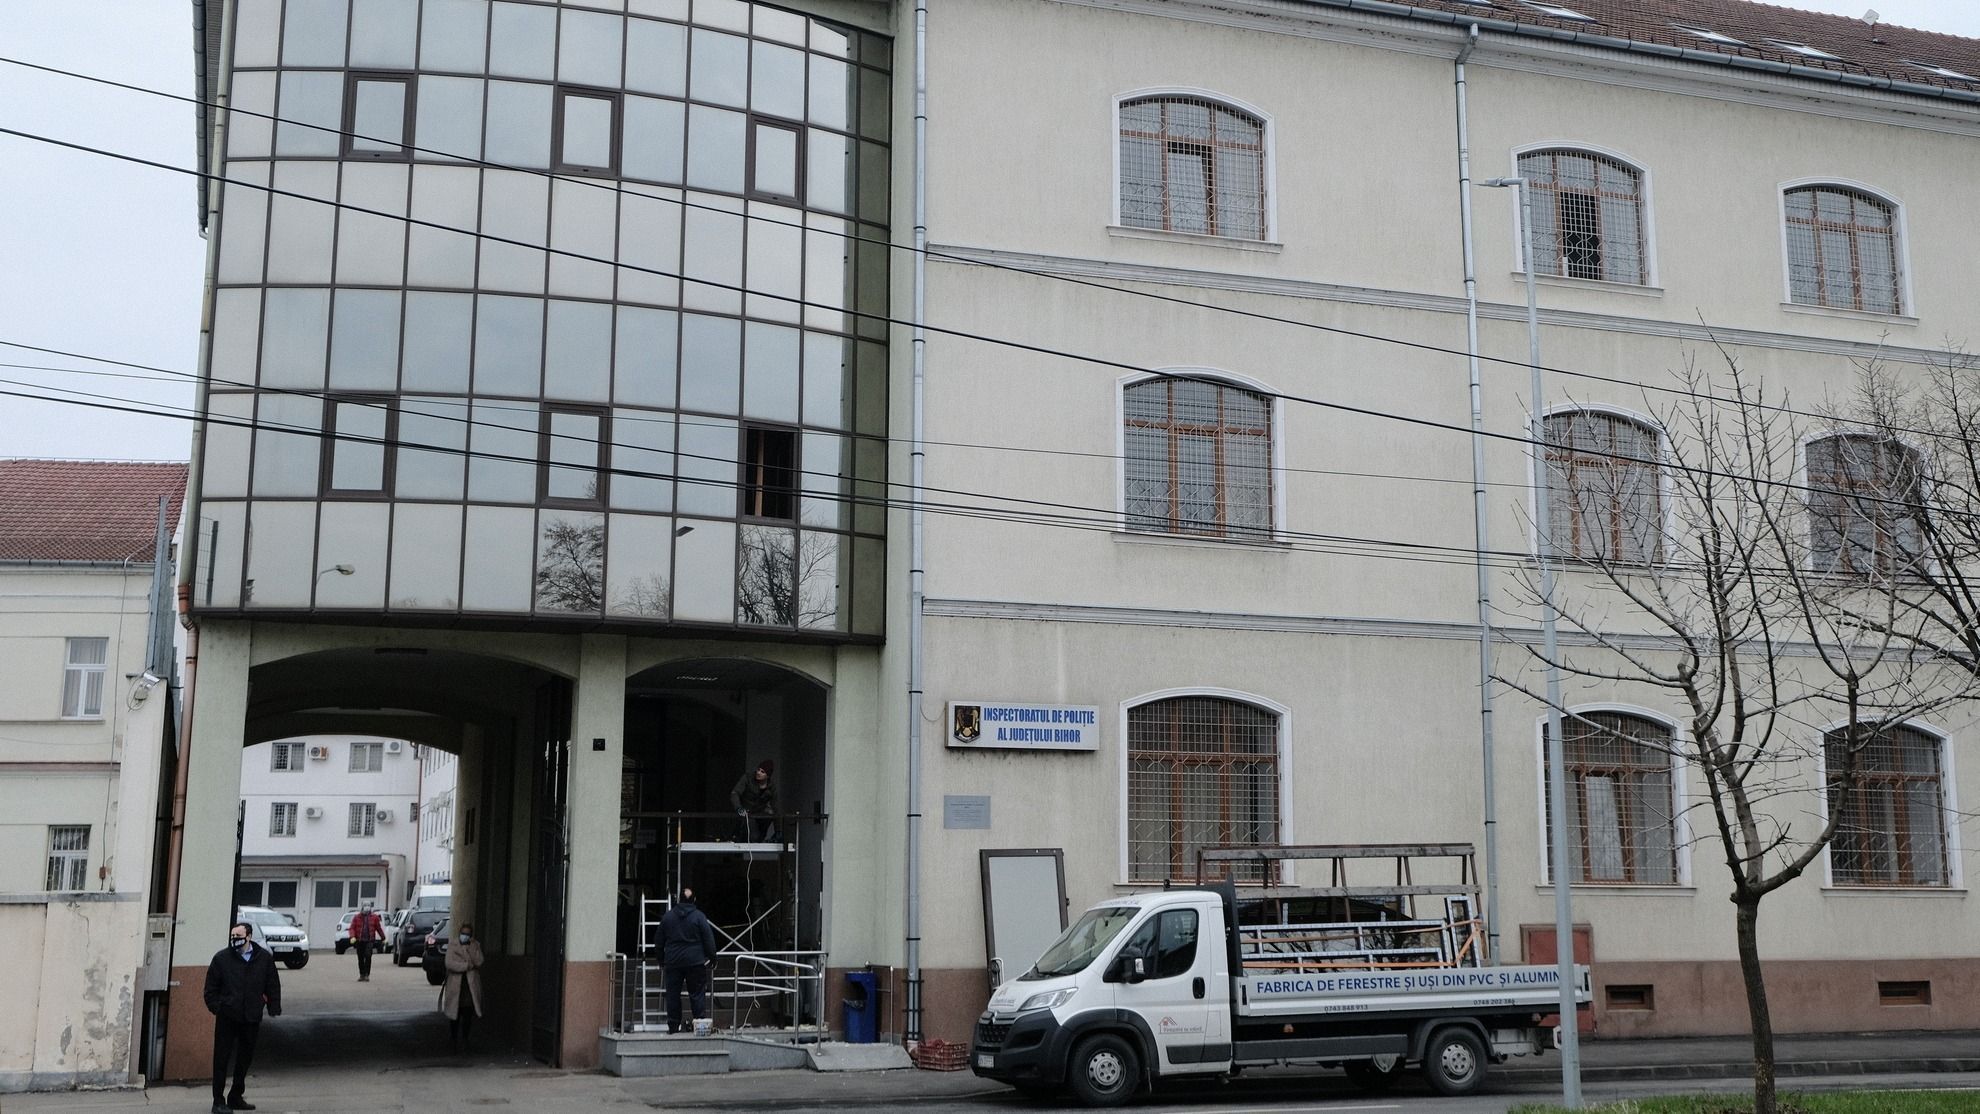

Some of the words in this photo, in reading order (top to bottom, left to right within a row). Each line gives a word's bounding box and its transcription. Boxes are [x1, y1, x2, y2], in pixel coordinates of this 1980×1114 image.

[983, 707, 1050, 723] INSPECTORATUL
[1052, 710, 1062, 723] DE
[997, 727, 1008, 741] AL
[1054, 729, 1081, 743] BIHOR
[1257, 980, 1314, 993] FABRICA
[1317, 979, 1335, 991] DE
[1338, 976, 1401, 990] FERESTRE
[1442, 974, 1465, 986] DIN
[1469, 973, 1494, 985] PVC
[1513, 970, 1560, 984] ALUMIN
